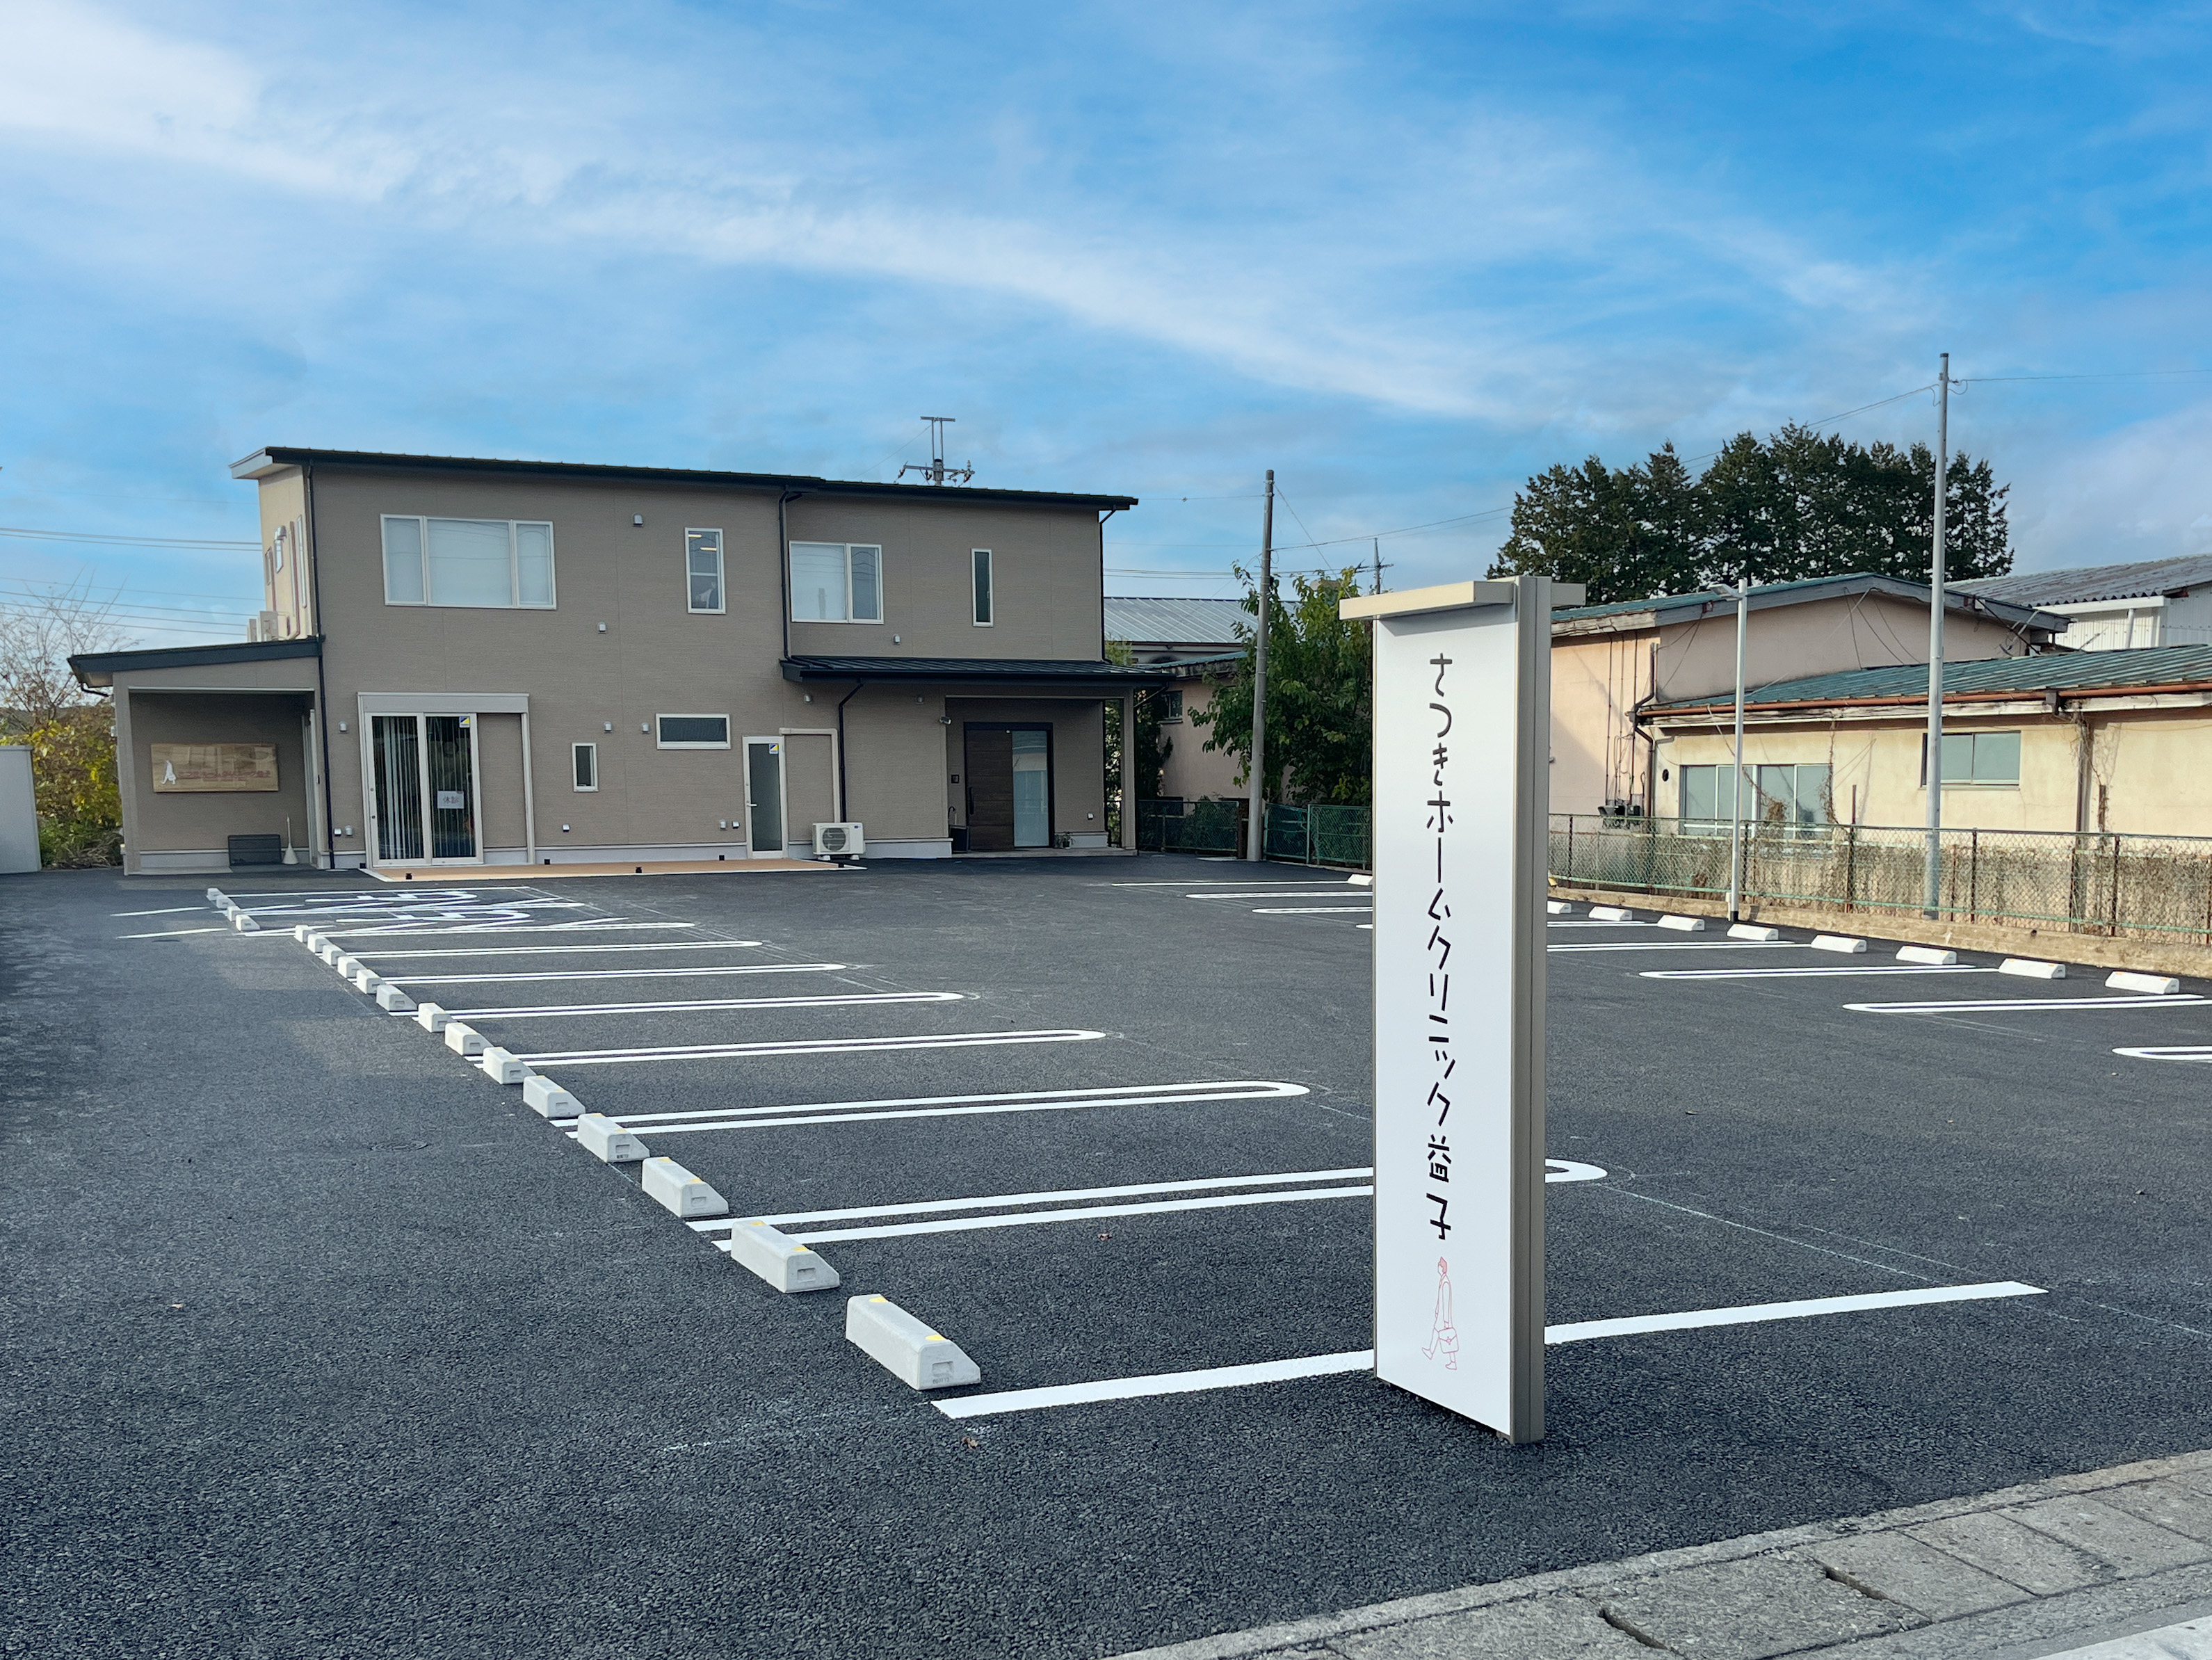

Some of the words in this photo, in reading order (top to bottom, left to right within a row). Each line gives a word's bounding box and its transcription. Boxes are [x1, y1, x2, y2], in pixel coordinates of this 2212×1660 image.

[1426, 652, 1456, 1241] さつきホームクリニック益子
